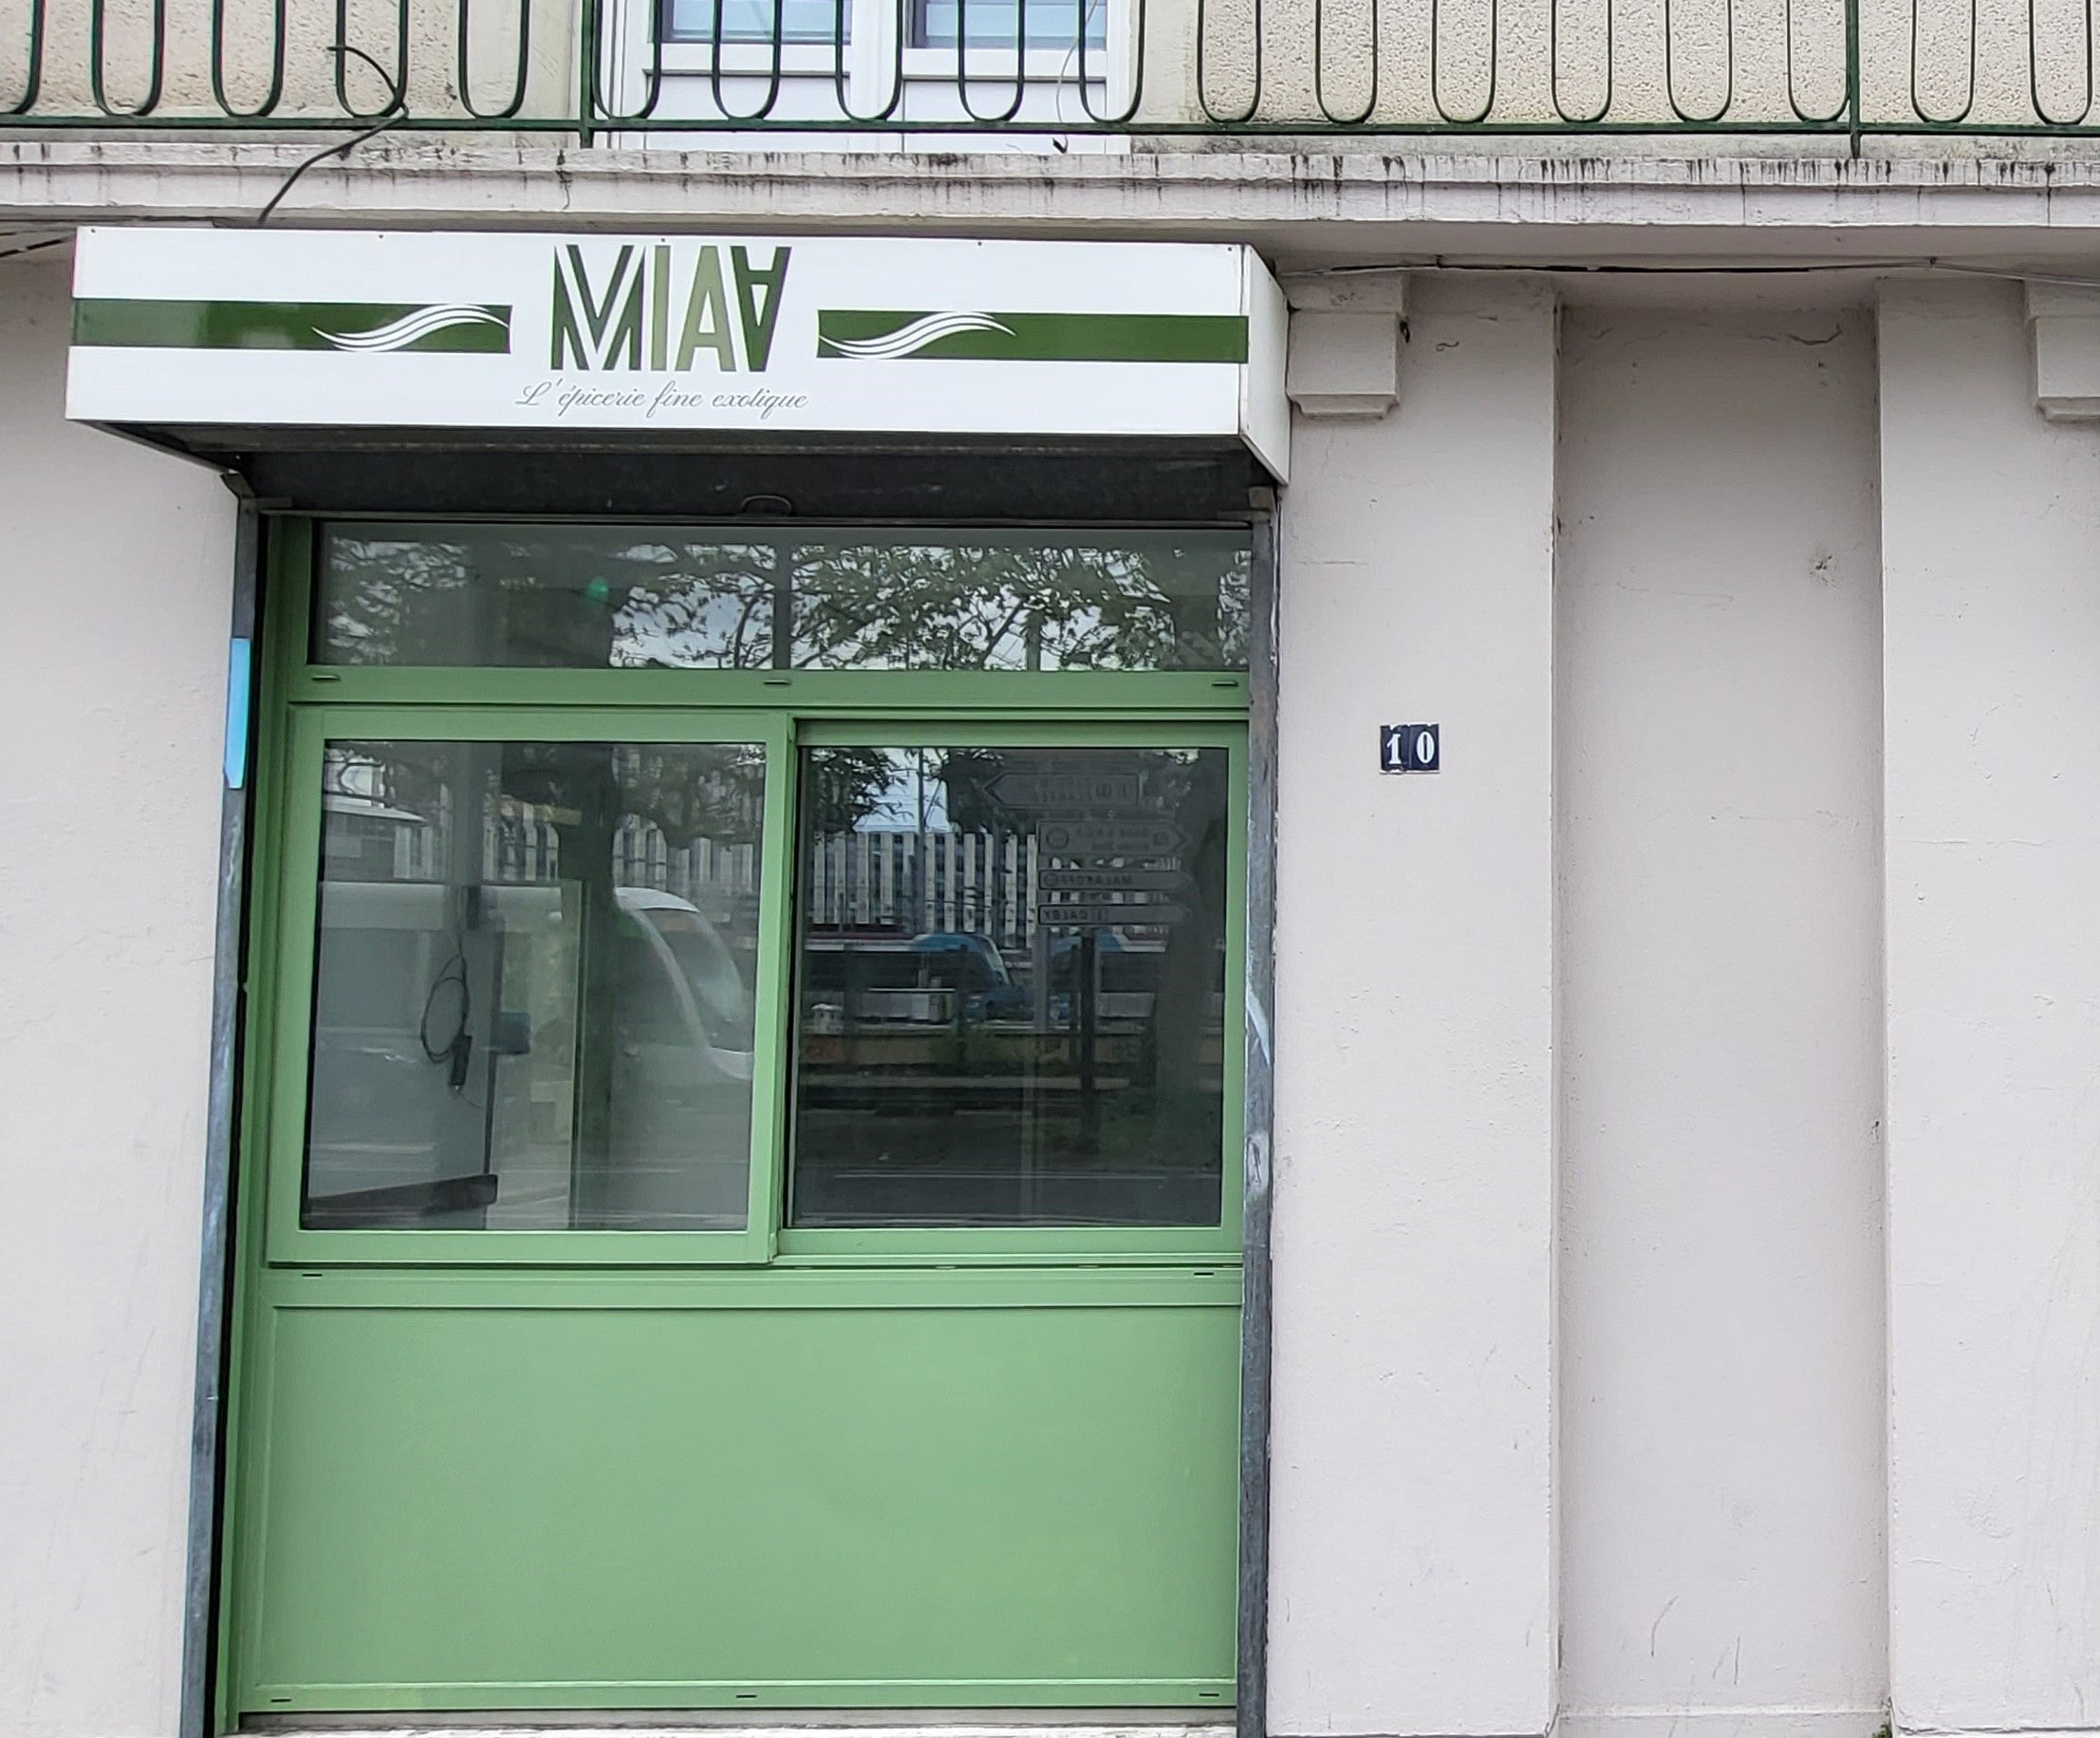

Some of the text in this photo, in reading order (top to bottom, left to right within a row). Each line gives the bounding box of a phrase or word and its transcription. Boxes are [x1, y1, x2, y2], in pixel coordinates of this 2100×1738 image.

[646, 380, 703, 419] fine
[712, 387, 808, 420] exotique
[1386, 731, 1435, 765] 10
